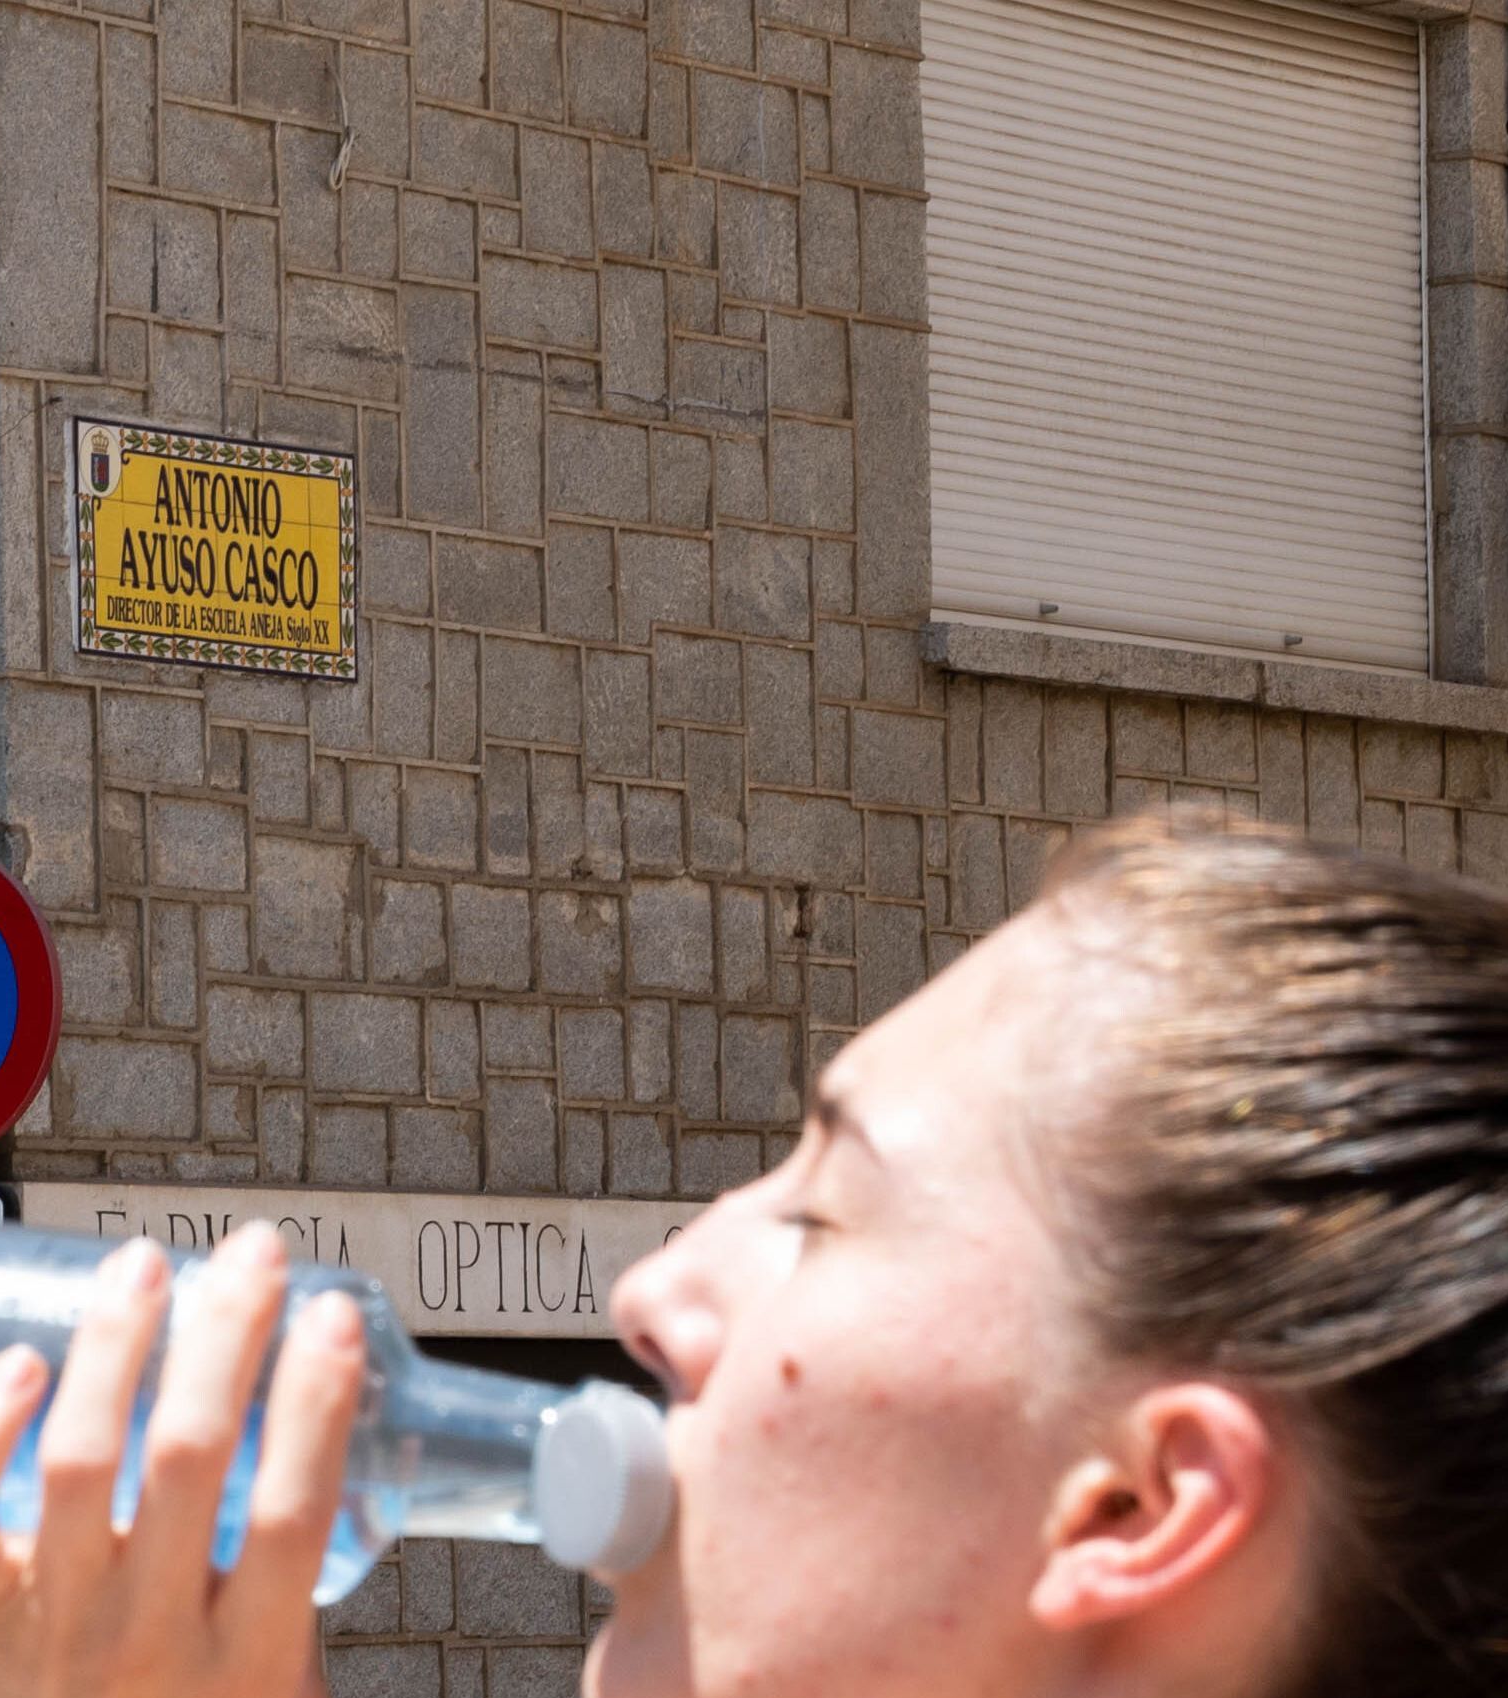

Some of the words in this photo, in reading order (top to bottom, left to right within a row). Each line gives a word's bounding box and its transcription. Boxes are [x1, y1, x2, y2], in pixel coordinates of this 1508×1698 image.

[154, 464, 282, 540] ANTONIO
[119, 527, 216, 599] AYUSO
[225, 541, 319, 611] CASCO
[107, 595, 162, 628] DIRECTOR
[166, 603, 181, 629] DE
[183, 605, 198, 631] LA
[200, 607, 247, 637] ESCUELA
[249, 612, 283, 641] ANEJA
[286, 617, 311, 648] Siglo
[313, 619, 330, 645] XX
[416, 1219, 600, 1315] OPTICA
